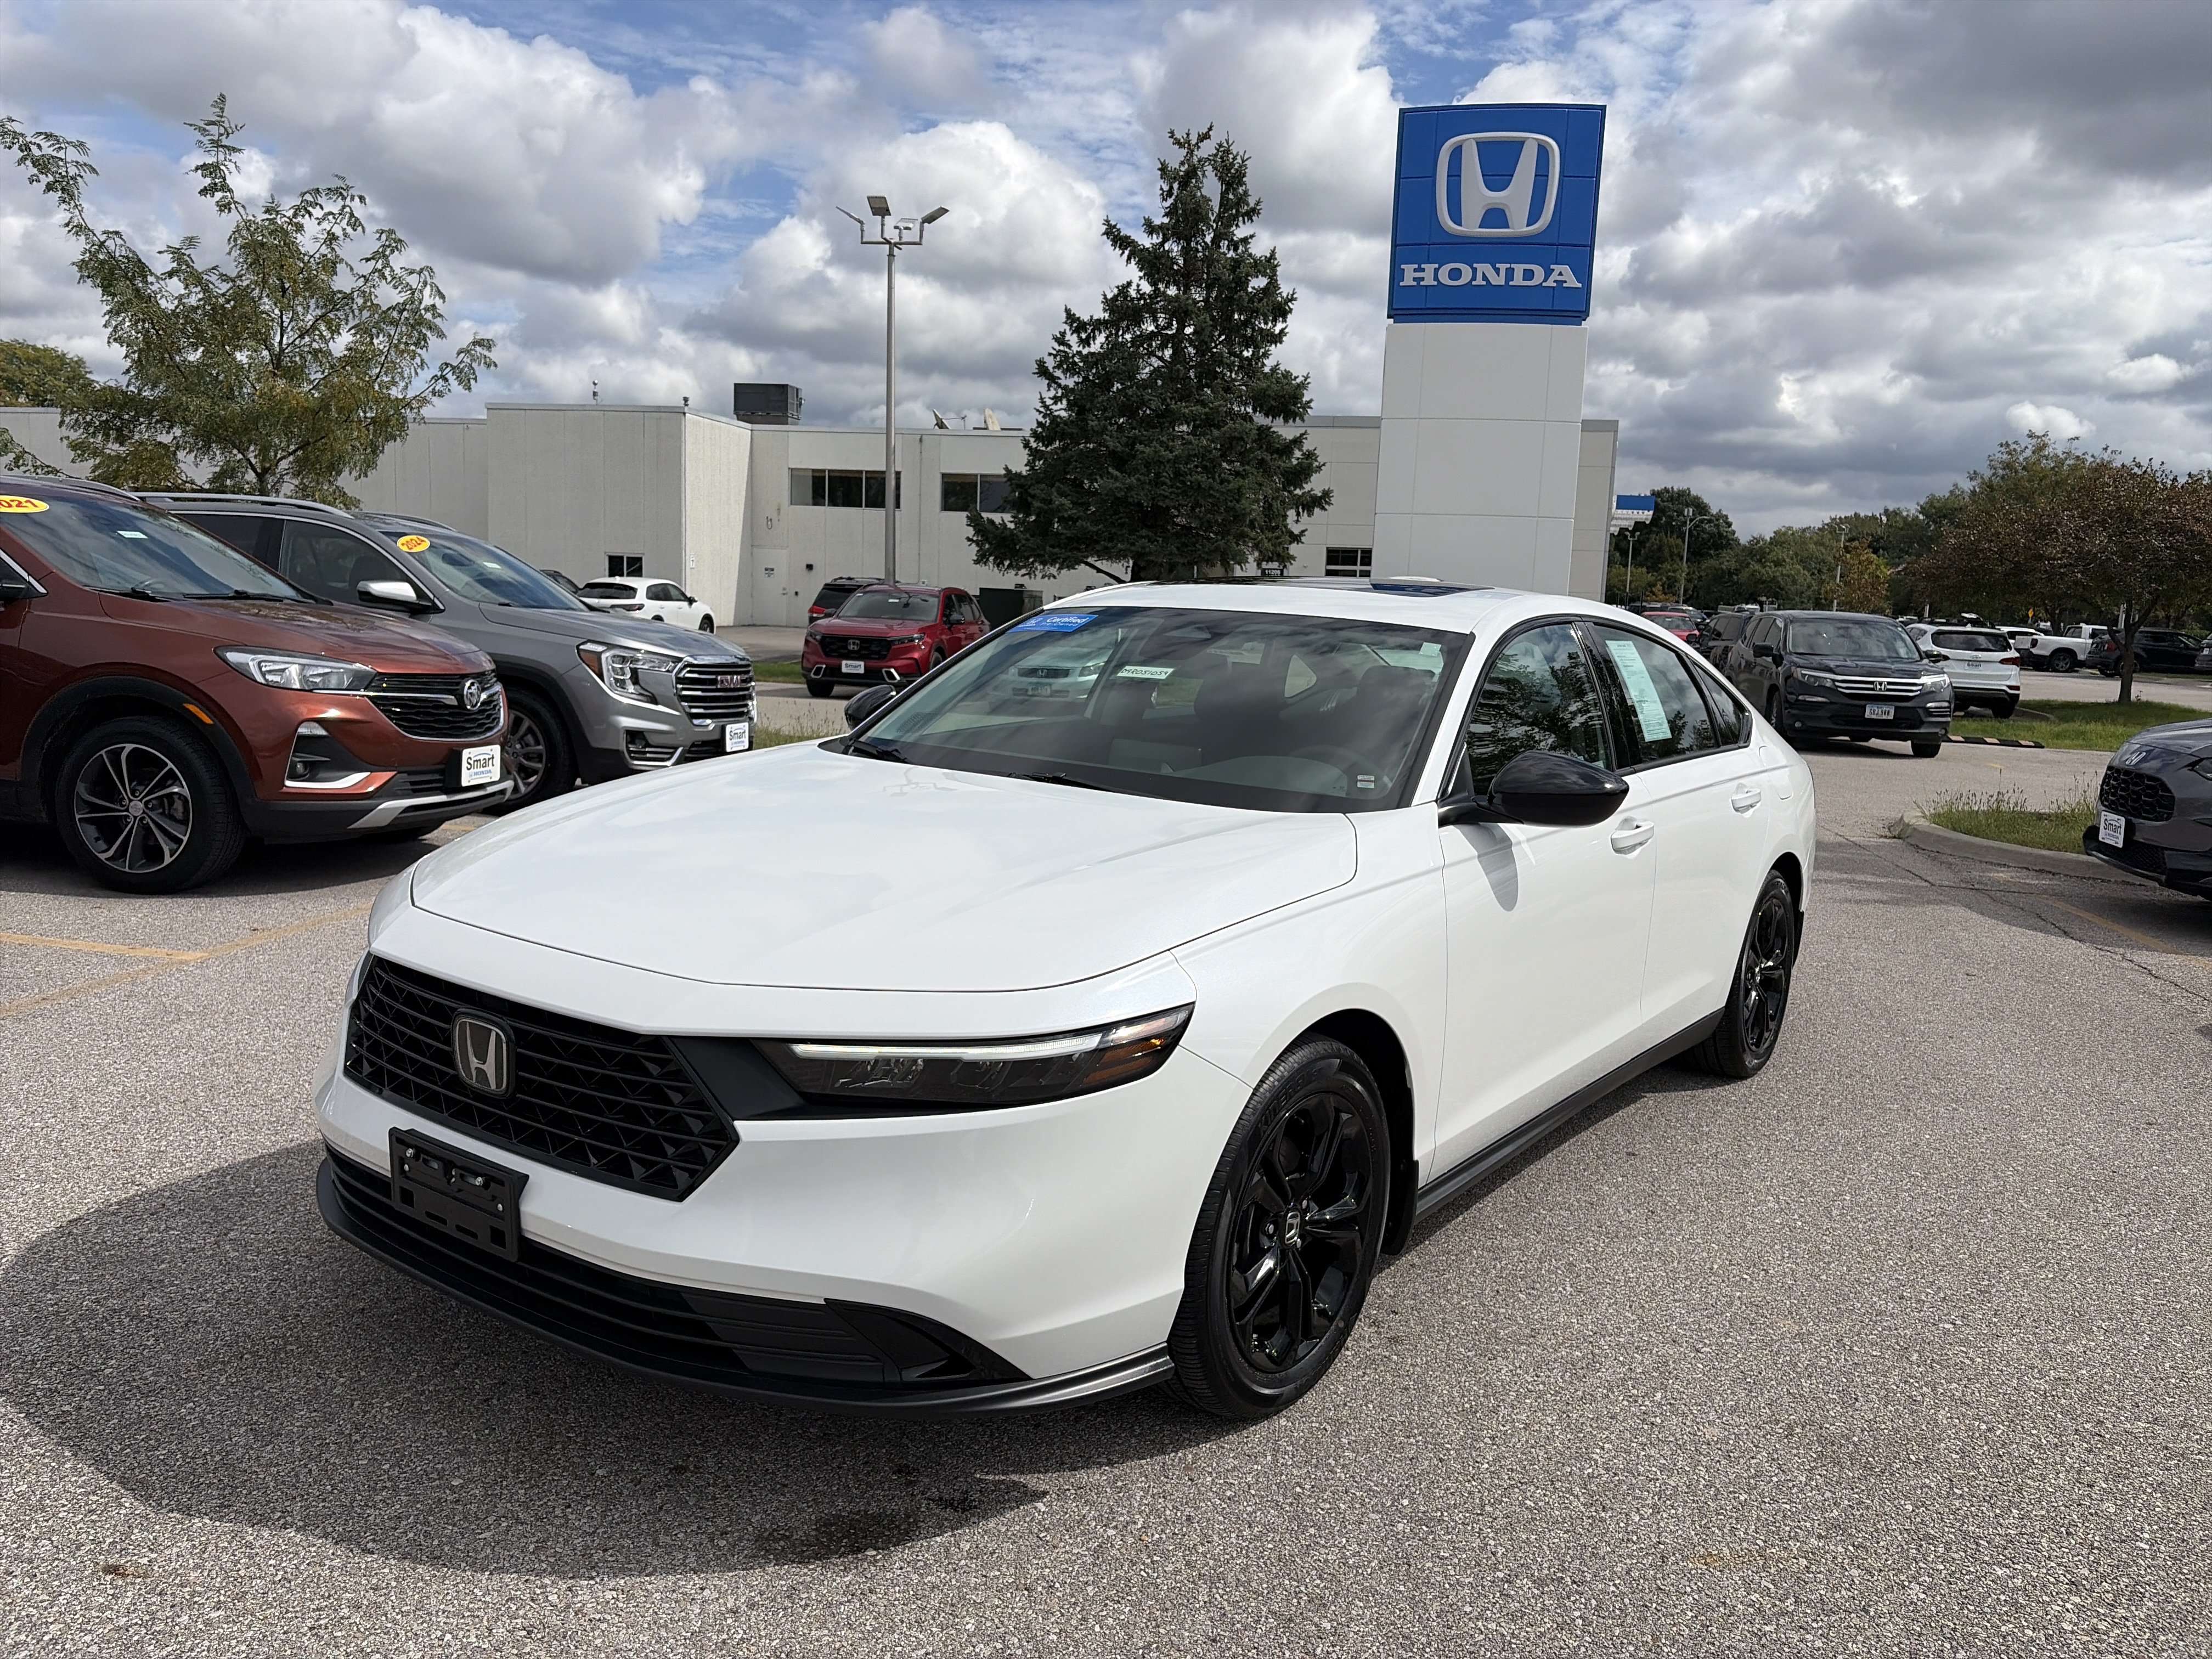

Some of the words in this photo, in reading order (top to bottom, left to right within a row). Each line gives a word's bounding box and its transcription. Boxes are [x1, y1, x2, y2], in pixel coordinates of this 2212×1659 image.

[1400, 263, 1582, 288] HONDA
[0, 499, 39, 509] 021
[729, 729, 746, 741] Smart
[466, 754, 495, 771] Smart
[2103, 818, 2122, 836] Smart
